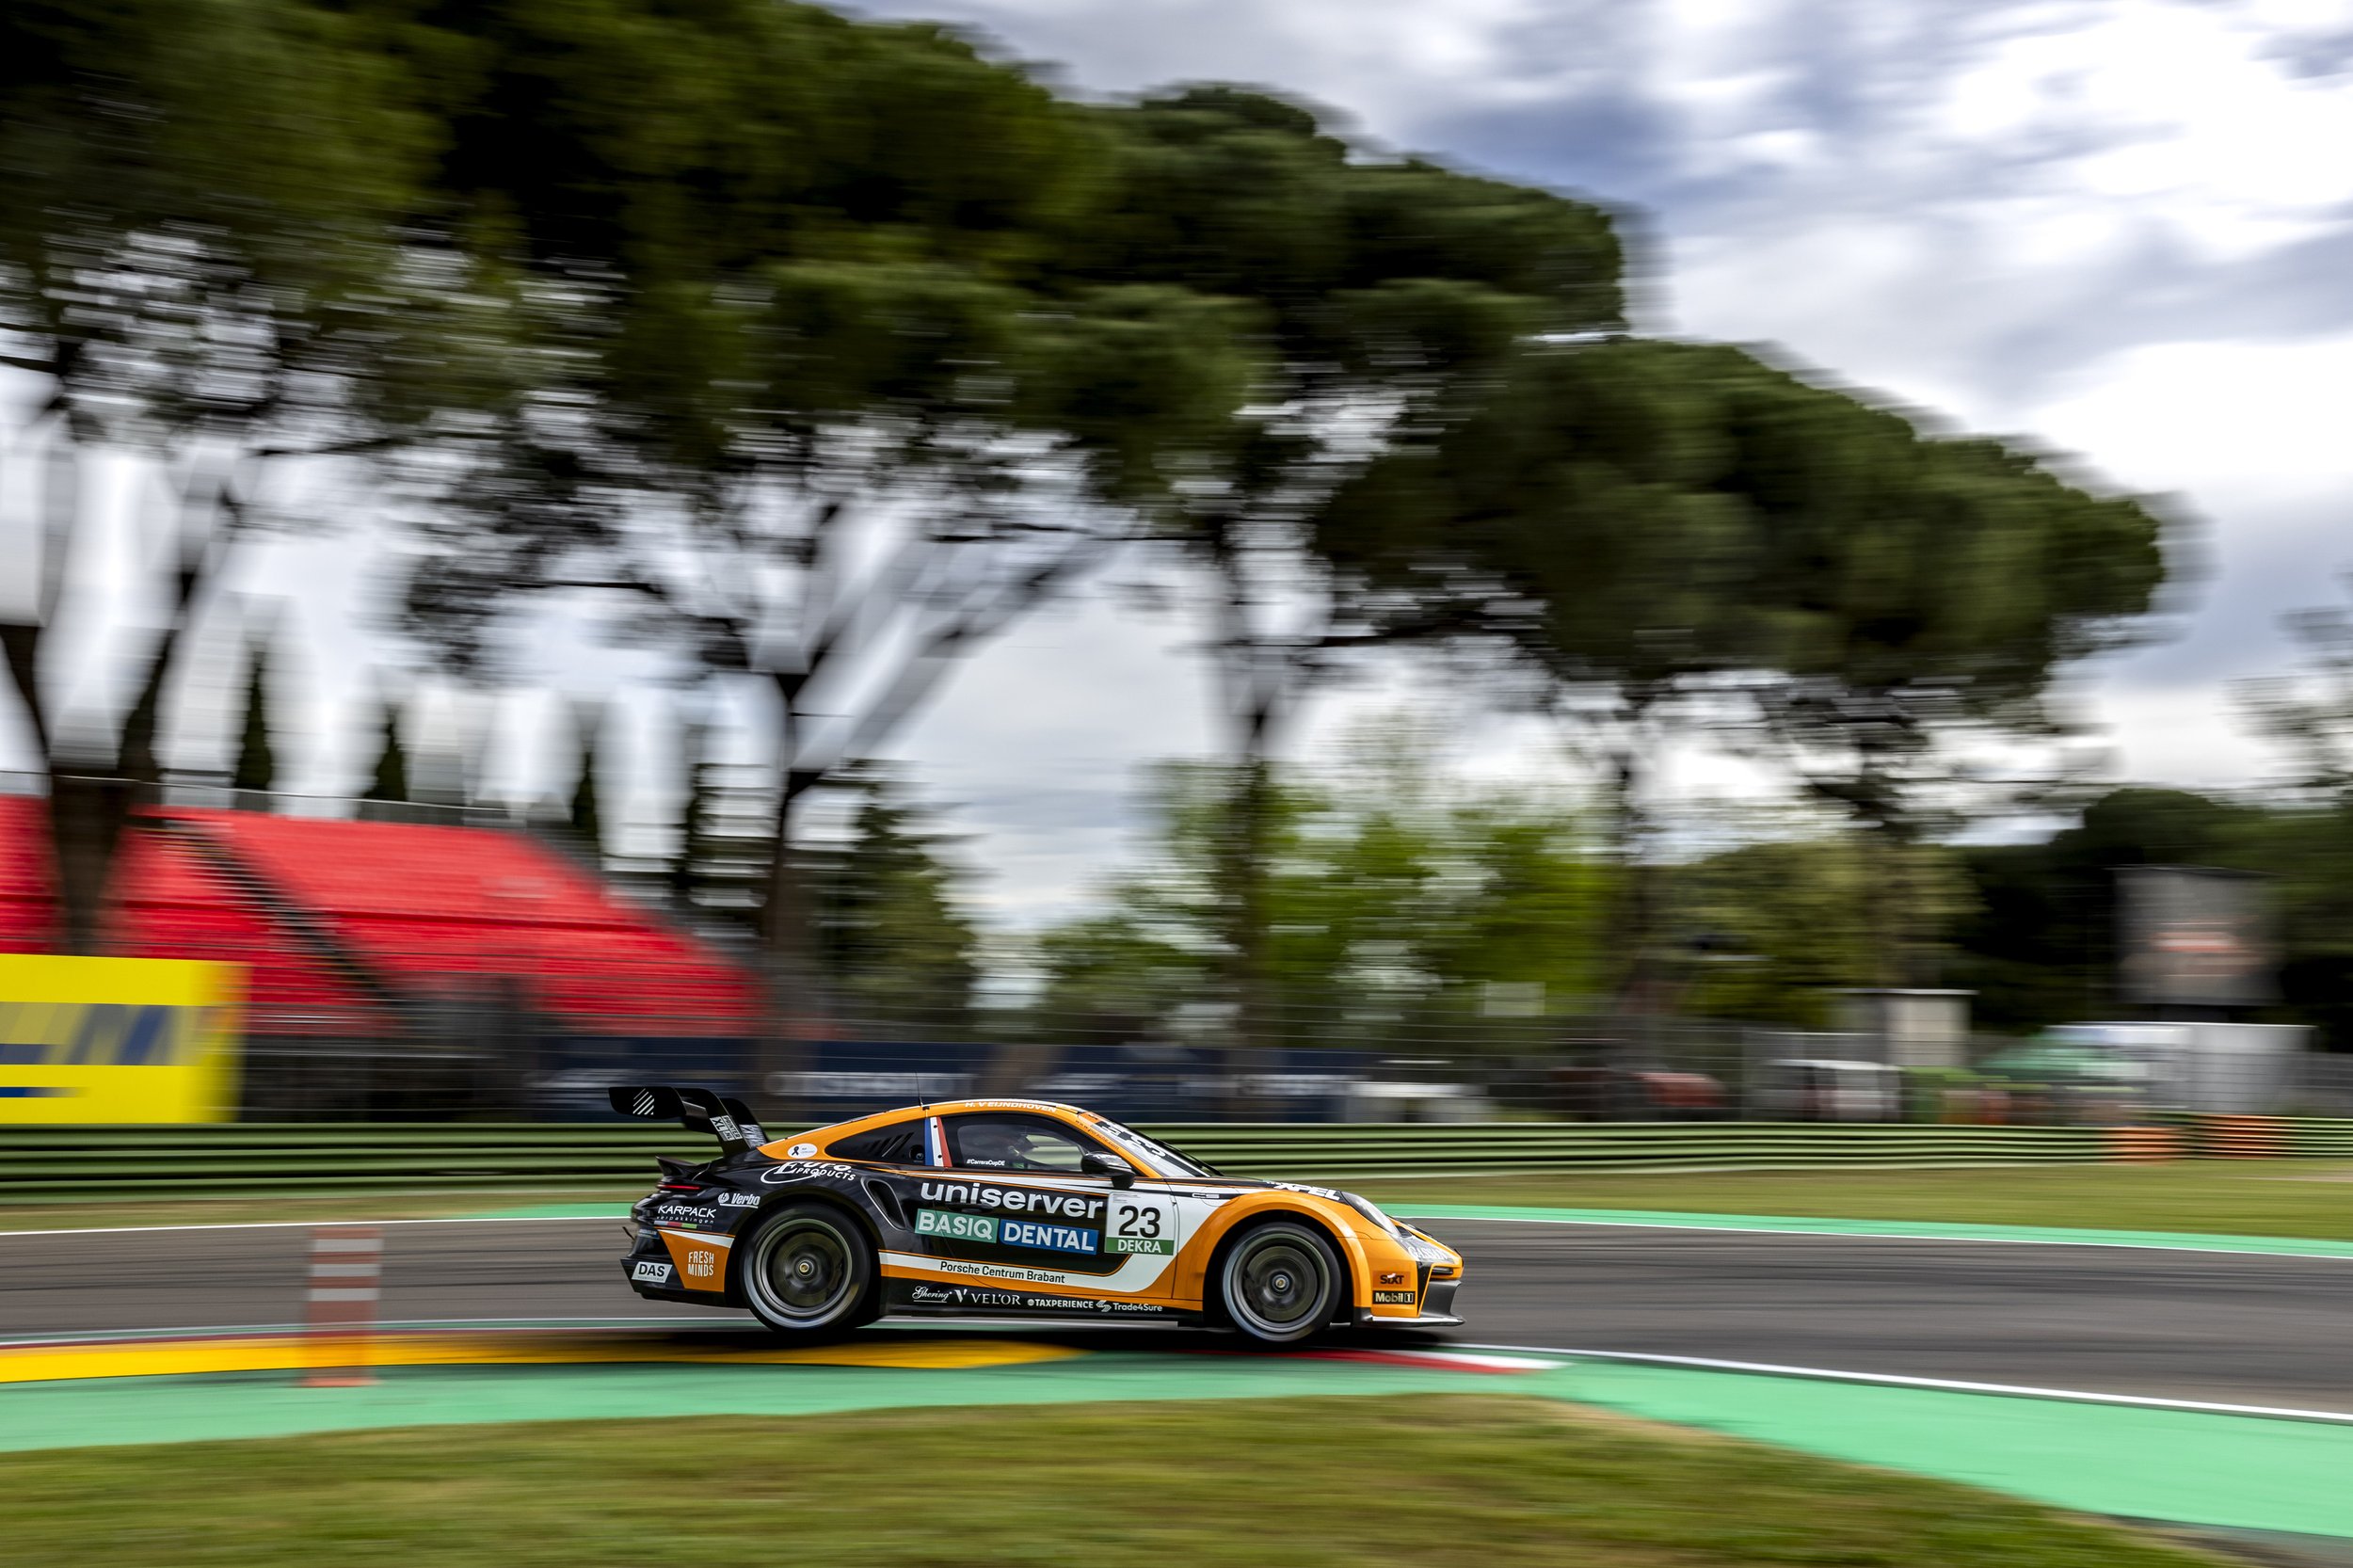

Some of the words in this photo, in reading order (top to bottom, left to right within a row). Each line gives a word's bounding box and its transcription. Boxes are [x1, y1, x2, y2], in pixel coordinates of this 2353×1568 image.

[712, 1118, 726, 1131] XL
[795, 1167, 856, 1181] PRODUCTS
[1273, 1182, 1340, 1201] XPEL
[731, 1192, 760, 1206] Verbo
[920, 1182, 1103, 1219] uniserver
[658, 1205, 716, 1219] KARPACK
[1118, 1205, 1160, 1239] 23
[919, 1211, 992, 1240] BASIQ
[1003, 1223, 1094, 1251] DENTAL
[1117, 1239, 1162, 1253] DEKRA
[688, 1251, 714, 1265] FRESH
[638, 1264, 665, 1277] DAS
[687, 1264, 713, 1277] MINDS
[940, 1261, 980, 1274] Porsche
[982, 1266, 1024, 1279] Centrum
[1027, 1271, 1065, 1283] Brabant
[1035, 1299, 1094, 1309] TAXPERIENCE
[1375, 1292, 1403, 1303] Mobil
[1112, 1303, 1162, 1312] Trade4Sure
